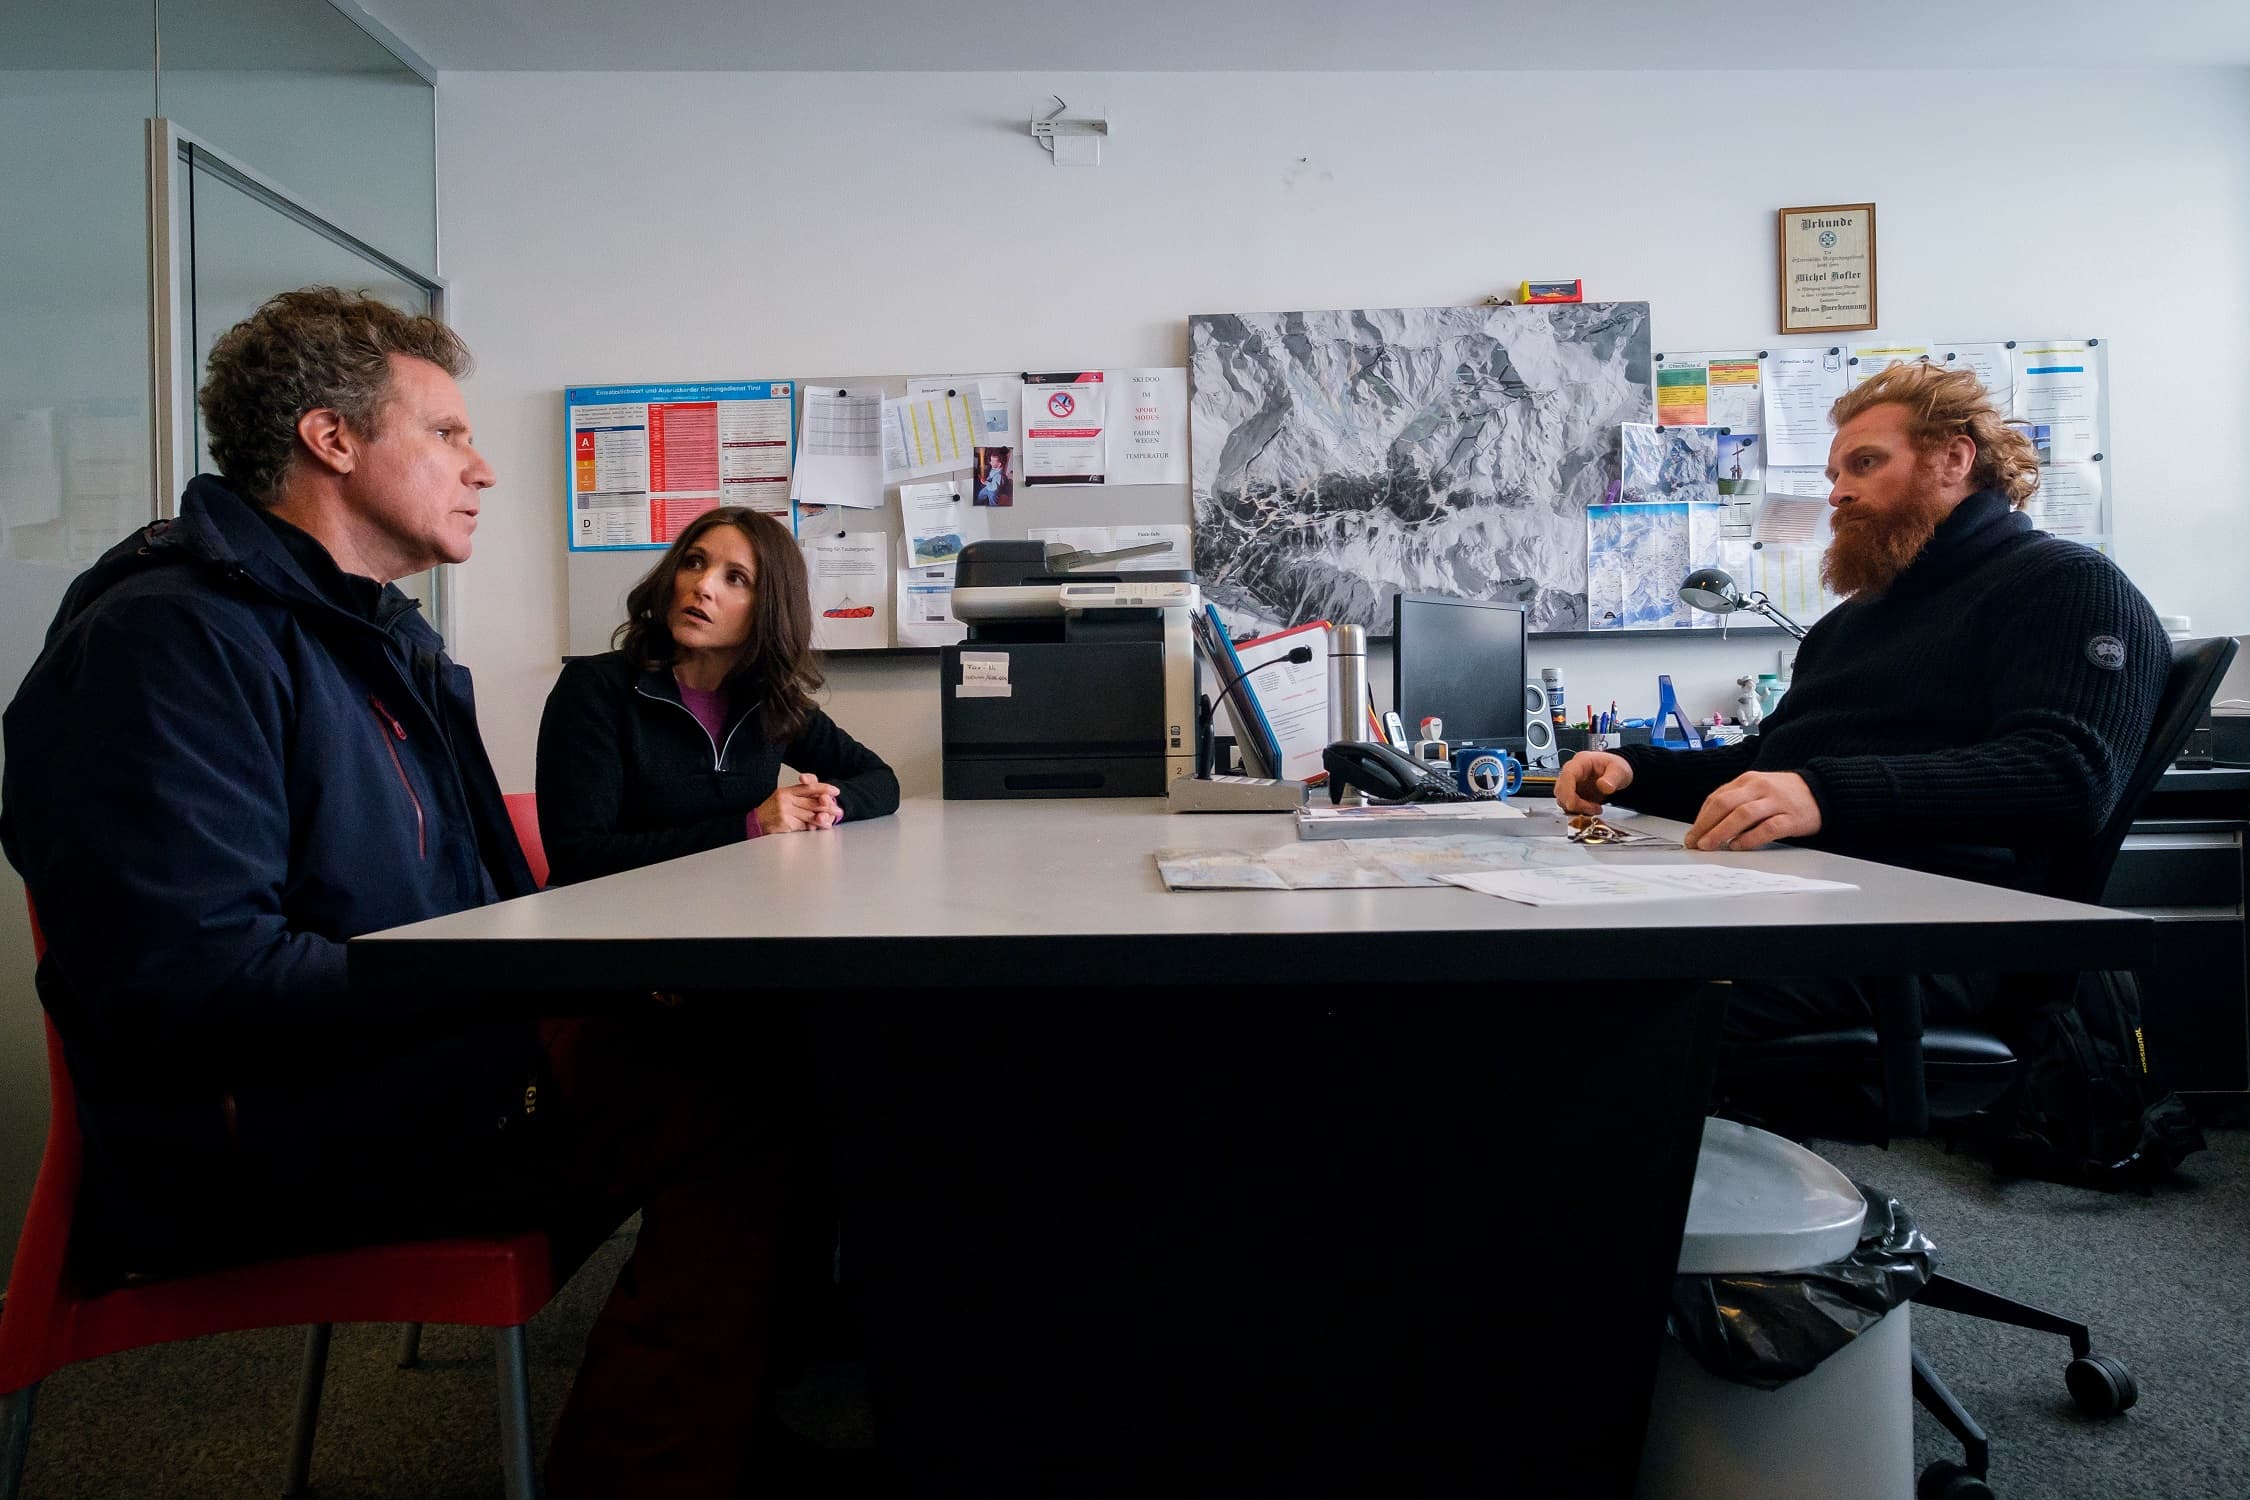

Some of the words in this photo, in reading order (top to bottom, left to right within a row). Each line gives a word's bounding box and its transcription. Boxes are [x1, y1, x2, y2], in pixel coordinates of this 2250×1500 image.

[1801, 217, 1853, 231] Urkunde
[1795, 272, 1827, 284] Michel
[581, 438, 590, 447] A
[1125, 452, 1169, 460] TEMPERATUR
[583, 519, 591, 528] D
[2135, 1027, 2147, 1073] ROSSIGNOL
